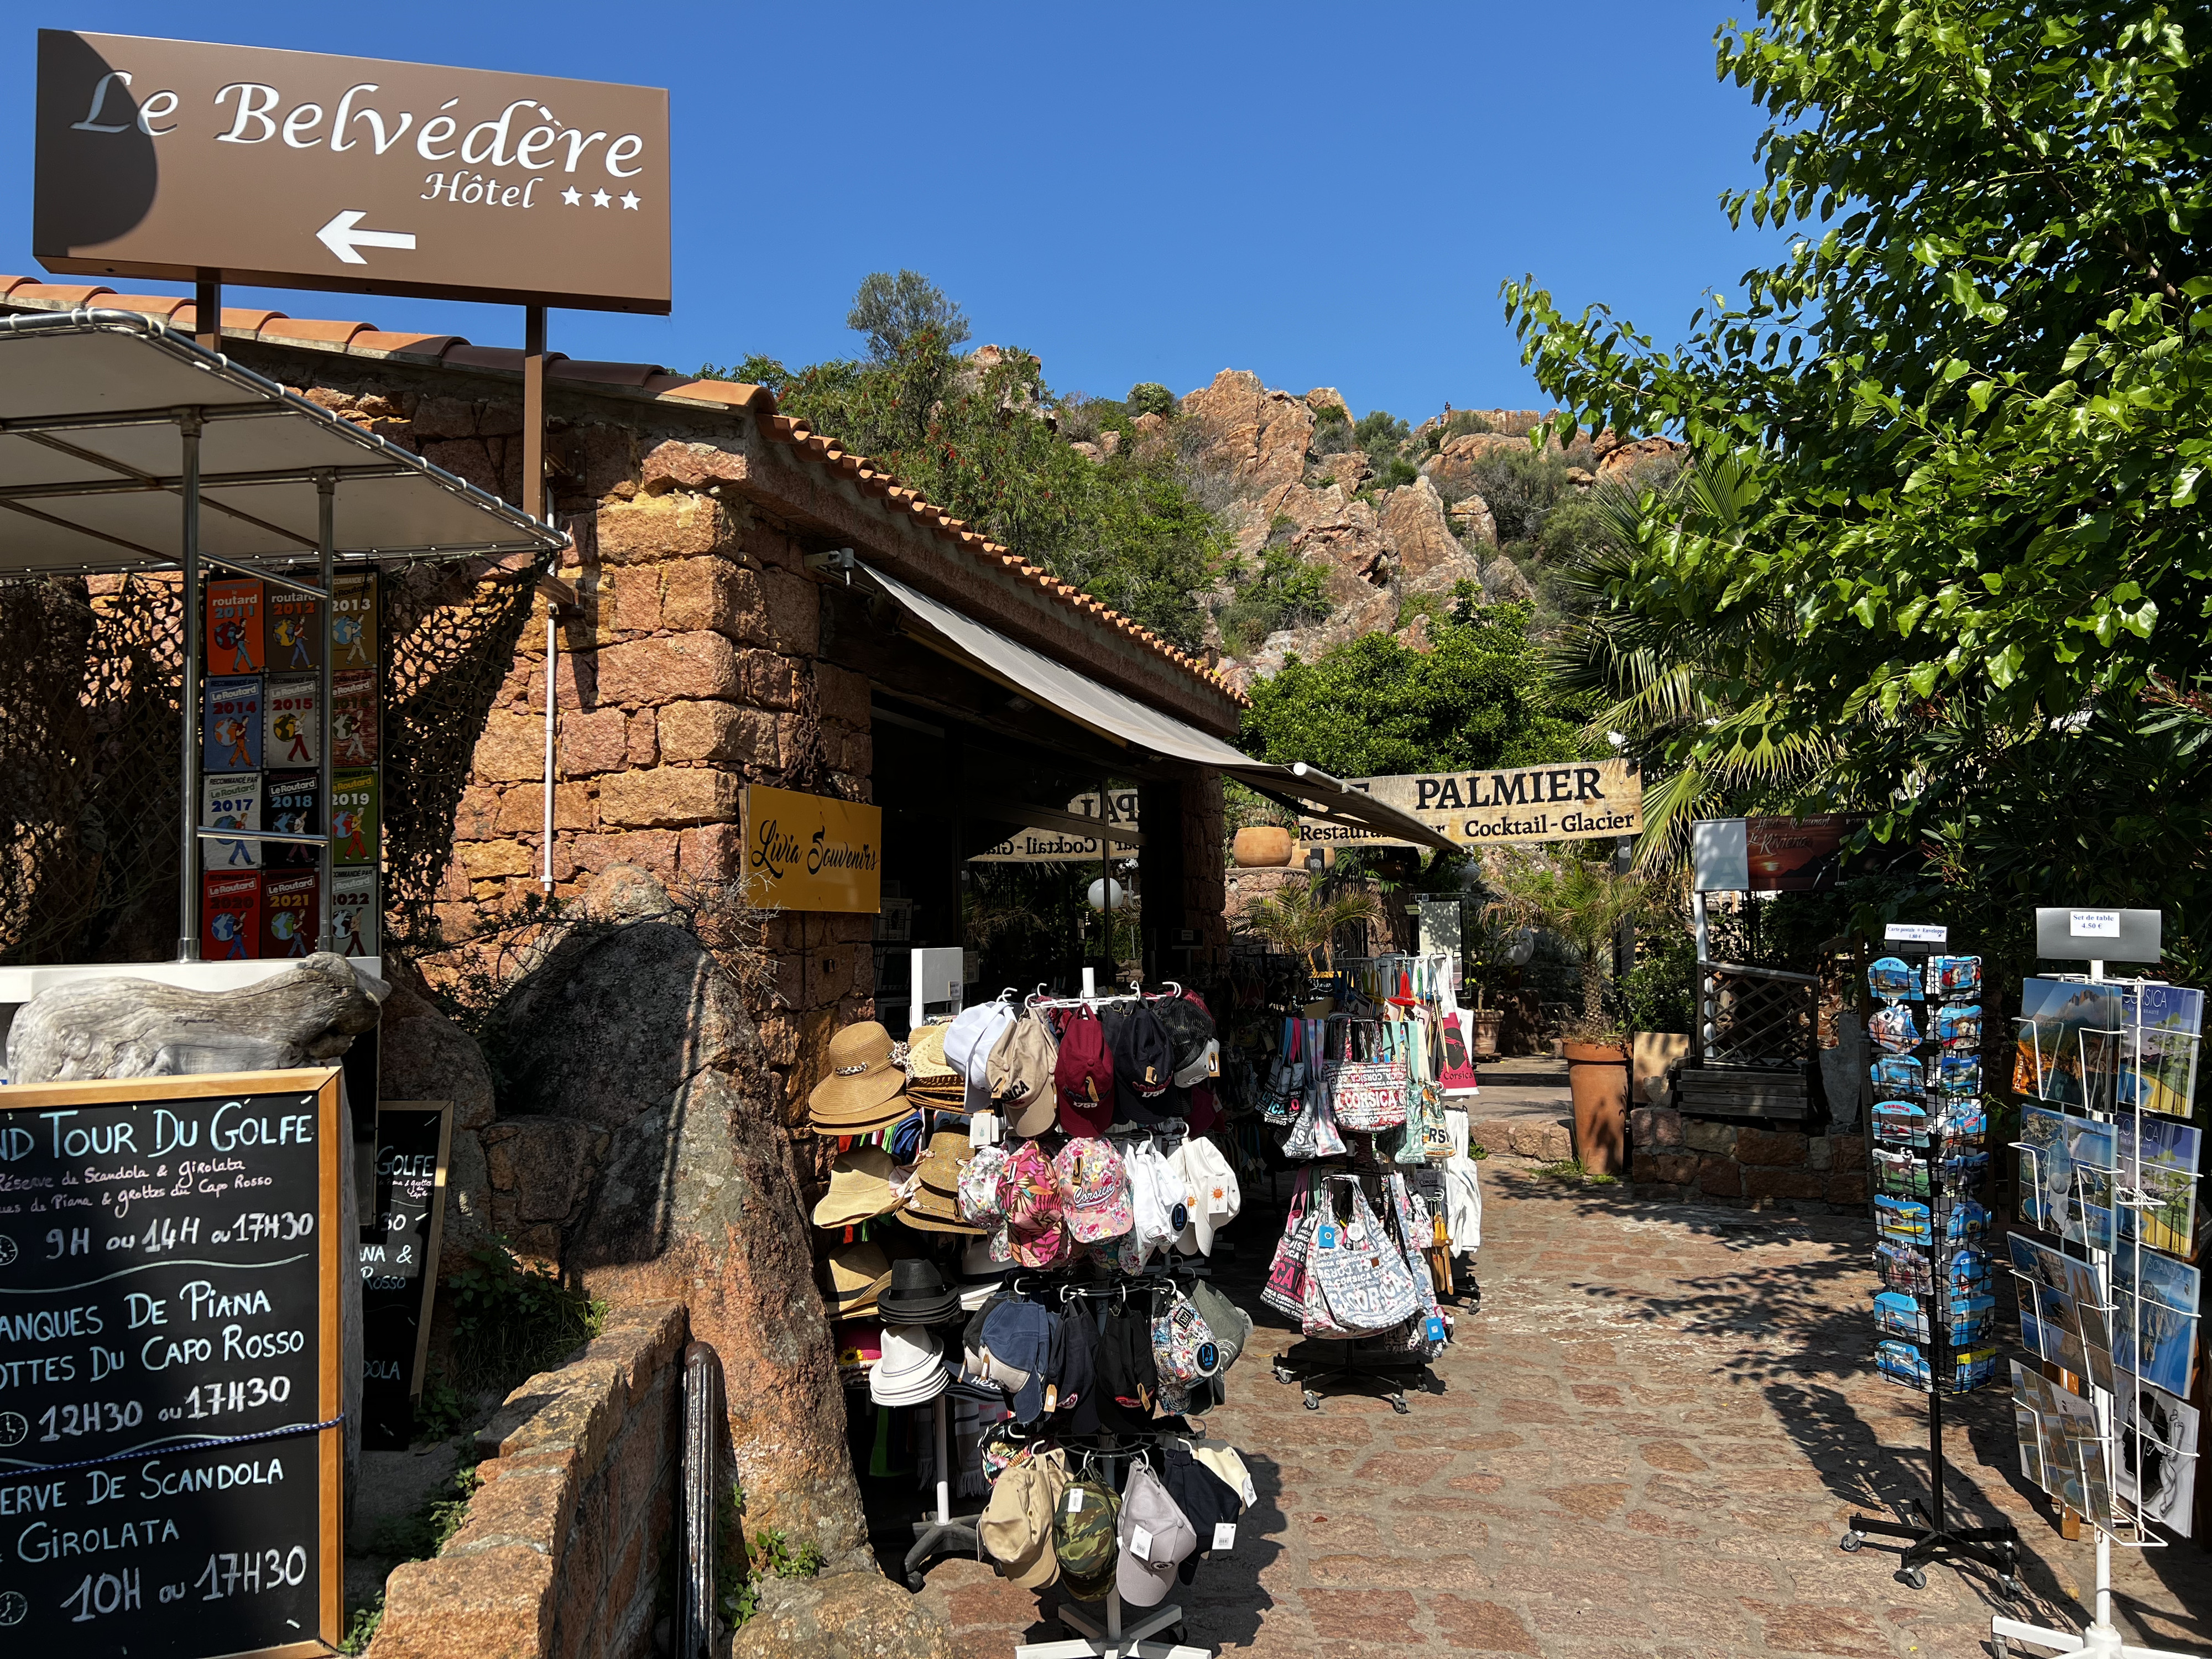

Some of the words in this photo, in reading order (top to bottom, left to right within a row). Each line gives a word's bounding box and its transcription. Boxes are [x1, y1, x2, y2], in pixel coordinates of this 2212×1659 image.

[70, 70, 179, 136] Le
[215, 82, 643, 178] Belvédère
[421, 171, 545, 211] Hôtel
[212, 594, 258, 607] routard
[271, 592, 316, 603] routard
[333, 598, 371, 612] 2013
[215, 605, 254, 619] 2011
[273, 602, 315, 615] 2012
[212, 692, 222, 701] Le
[222, 685, 257, 698] Routard
[272, 689, 281, 698] Le
[281, 682, 314, 696] Routard
[338, 681, 369, 694] Routard
[213, 701, 257, 714] 2014
[273, 698, 313, 711] 2015
[211, 790, 221, 799] Le
[221, 784, 255, 797] Routard
[270, 786, 281, 795] Le
[281, 780, 315, 794] Routard
[338, 777, 372, 790] Routard
[1416, 768, 1604, 810] PALMIER
[211, 799, 253, 812] 2017
[271, 795, 312, 808] 2018
[332, 793, 369, 806] 2019
[1465, 814, 1547, 837] Cocktail
[1561, 812, 1635, 832] Glacier
[1788, 816, 1830, 830] Retaurant
[1300, 825, 1391, 842] Restaura
[751, 819, 803, 879] Livia
[807, 825, 879, 875] Souvenirs
[1760, 833, 1809, 856] Riviera
[210, 887, 220, 895] Le
[220, 880, 255, 894] Routard
[268, 885, 279, 895] Le
[279, 878, 313, 892] Routard
[210, 895, 254, 909] 2020
[269, 894, 309, 907] 2021
[1879, 959, 1900, 968] CORSICA
[1443, 1071, 1474, 1080] Corsica
[1345, 1091, 1397, 1108] CORSICA
[148, 1108, 198, 1157] DU
[210, 1102, 315, 1152] GOLFE
[376, 1145, 435, 1177] GOLFE
[1874, 1151, 1894, 1160] CORSICA
[61, 1170, 80, 1186] de
[84, 1164, 150, 1184] Scandola
[156, 1164, 168, 1177] &
[30, 1196, 47, 1213] de
[50, 1193, 93, 1210] Piana
[101, 1191, 112, 1206] &
[170, 1180, 191, 1198] du
[198, 1180, 228, 1199] Capo
[234, 1172, 273, 1189] Rosso
[1073, 1184, 1115, 1204] Corsica
[45, 1227, 91, 1260] 9H
[106, 1234, 136, 1251] ou
[141, 1217, 201, 1253] 14H
[210, 1228, 232, 1244] ou
[232, 1211, 315, 1244] 17H30
[396, 1244, 413, 1264] &
[361, 1265, 406, 1291] ROSSO
[1334, 1273, 1372, 1286] CORSICA
[124, 1292, 169, 1329] DE
[90, 1346, 126, 1384] DU
[141, 1335, 212, 1371] CAPO
[222, 1324, 305, 1361] ROSSO
[1886, 1342, 1907, 1353] CORSICA
[39, 1400, 144, 1443] 12H30
[158, 1405, 183, 1421] ou
[184, 1375, 291, 1420] 17H30
[0, 1480, 68, 1516] ERVE
[86, 1469, 127, 1506] DE
[140, 1458, 284, 1500] SCANDOLA
[60, 1567, 141, 1624] 10H
[159, 1582, 186, 1605] ou
[194, 1546, 307, 1602] 17H30
